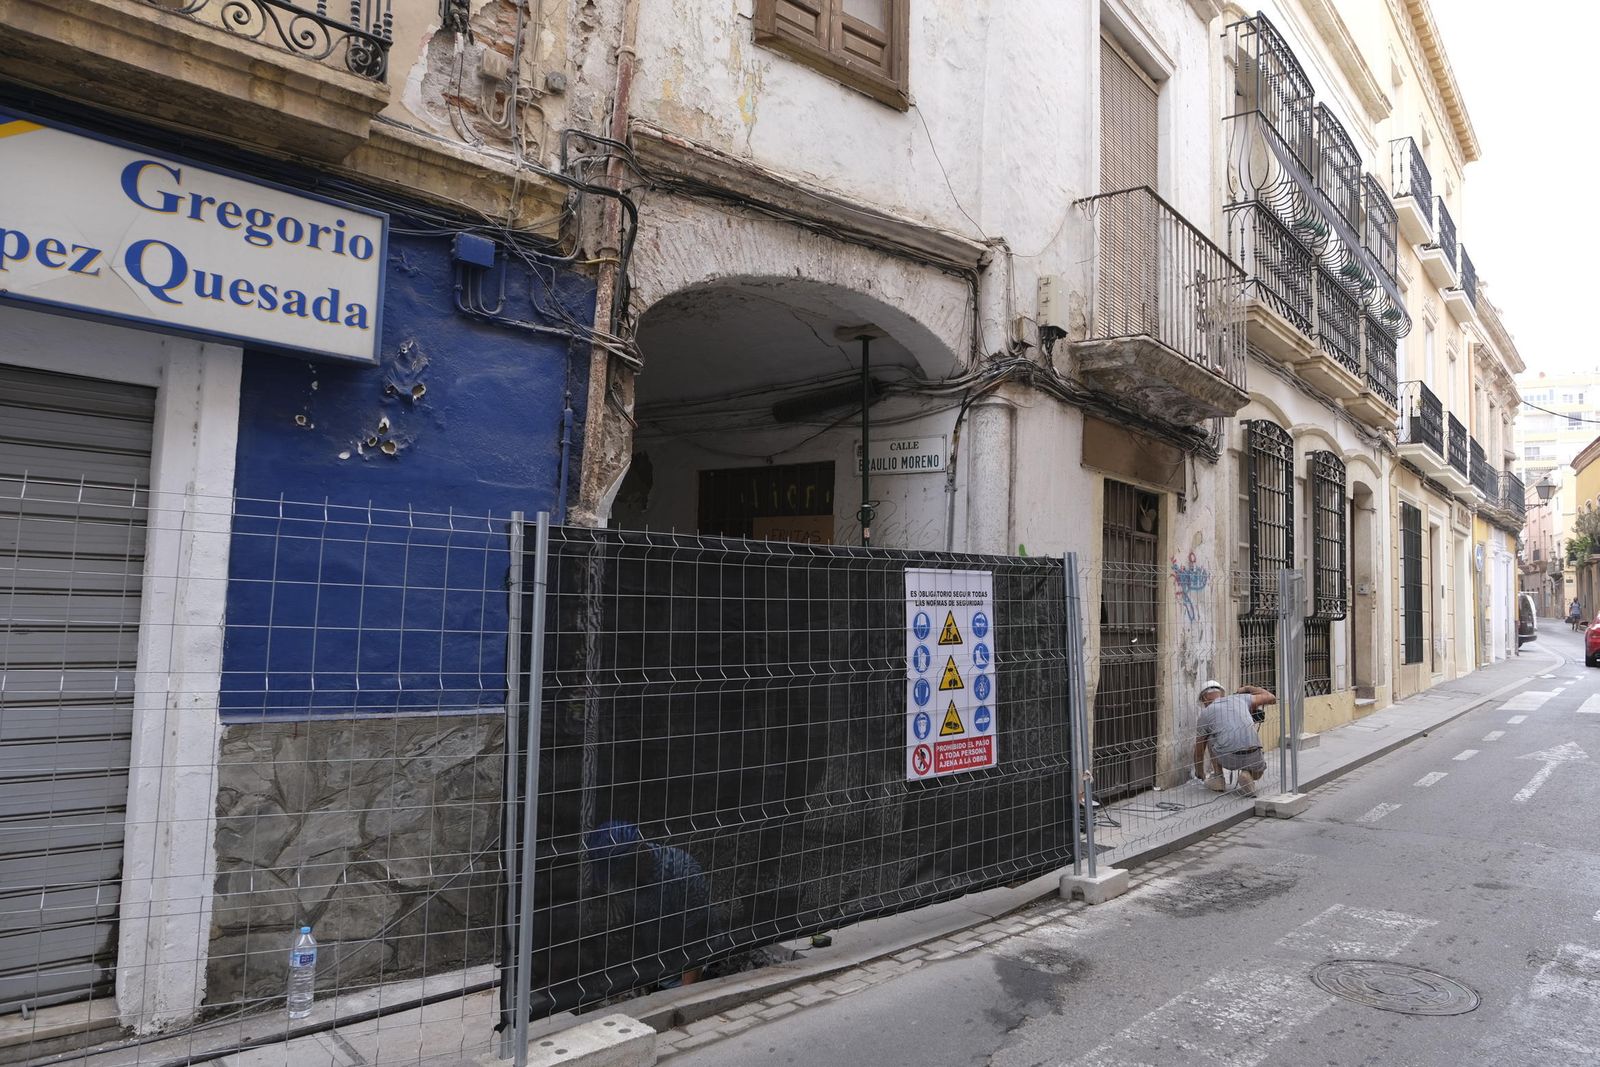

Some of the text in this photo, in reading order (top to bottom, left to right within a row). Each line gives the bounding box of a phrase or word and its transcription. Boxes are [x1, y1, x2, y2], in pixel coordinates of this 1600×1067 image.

[121, 160, 374, 260] Gregorio
[124, 239, 369, 329] Quesada
[890, 441, 919, 451] CALLE
[901, 454, 939, 469] MORENO
[936, 743, 966, 752] PROHIBIDO
[945, 751, 960, 759] TODA
[961, 747, 986, 757] PERSONA
[939, 759, 958, 768] AJENA
[972, 755, 987, 763] OBRA
